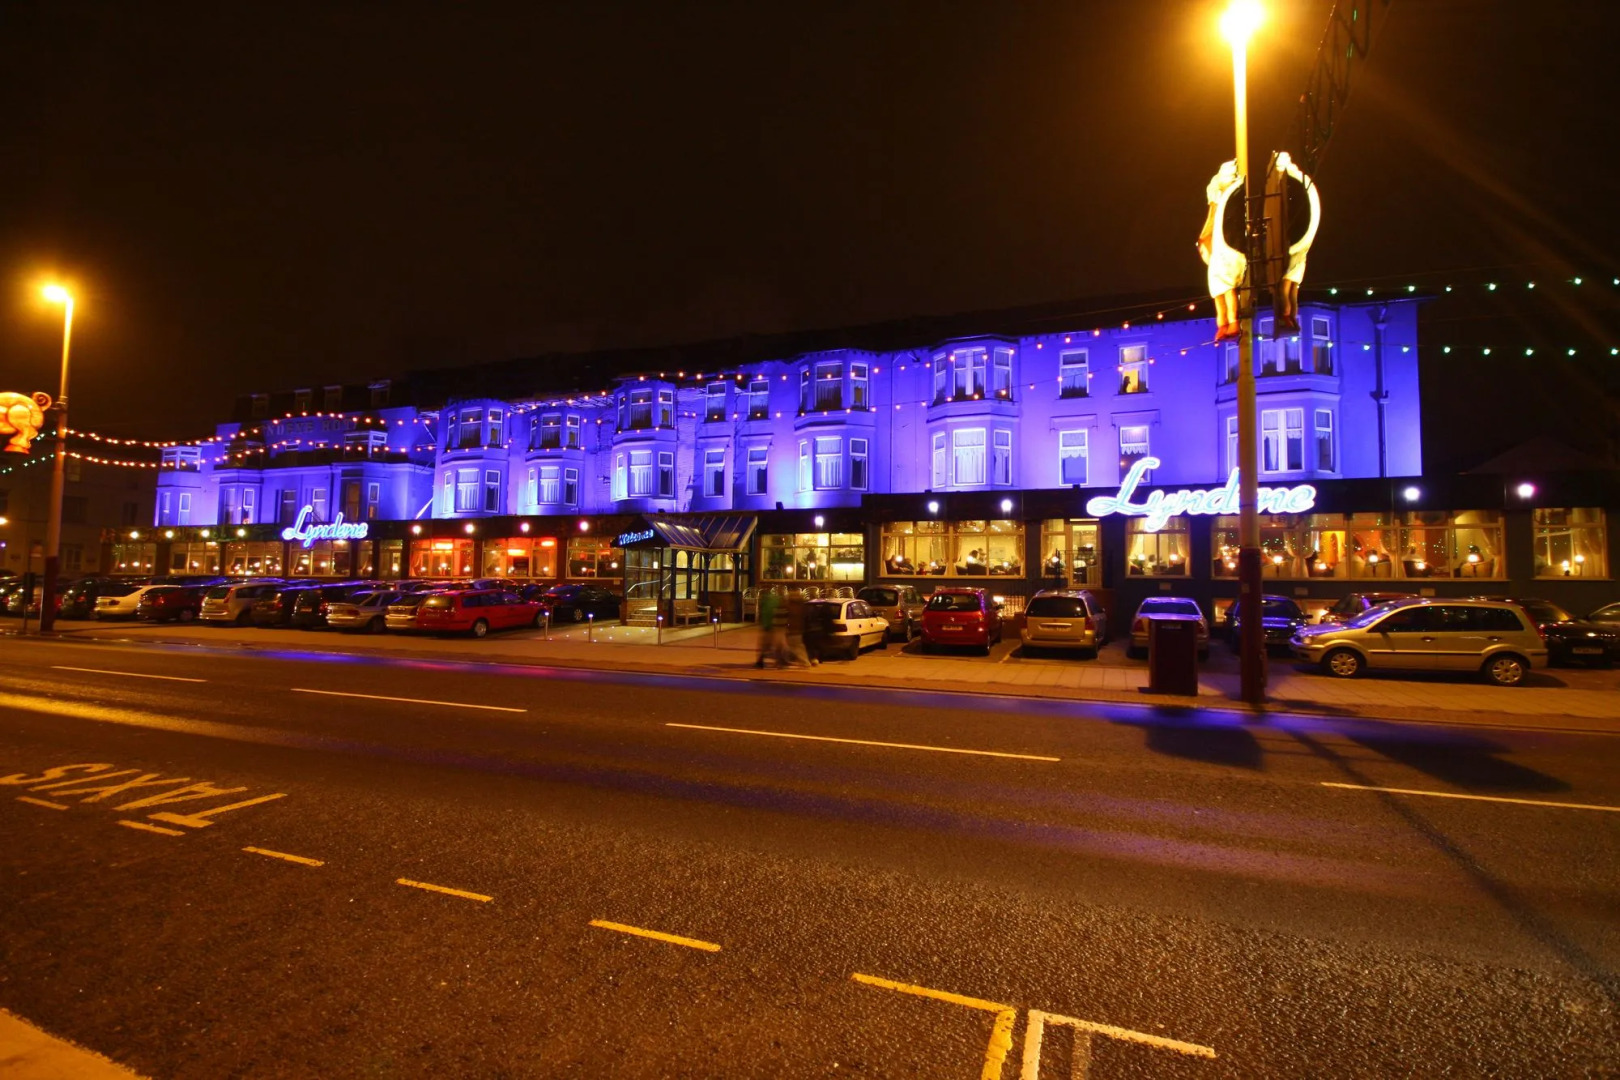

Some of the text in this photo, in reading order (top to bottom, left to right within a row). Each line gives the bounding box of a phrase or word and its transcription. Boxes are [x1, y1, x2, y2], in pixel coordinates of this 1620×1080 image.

[1087, 457, 1317, 532] Lyndne
[282, 505, 368, 548] Lyndene
[618, 529, 654, 545] Welcome
[0, 763, 288, 829] TAXIS
